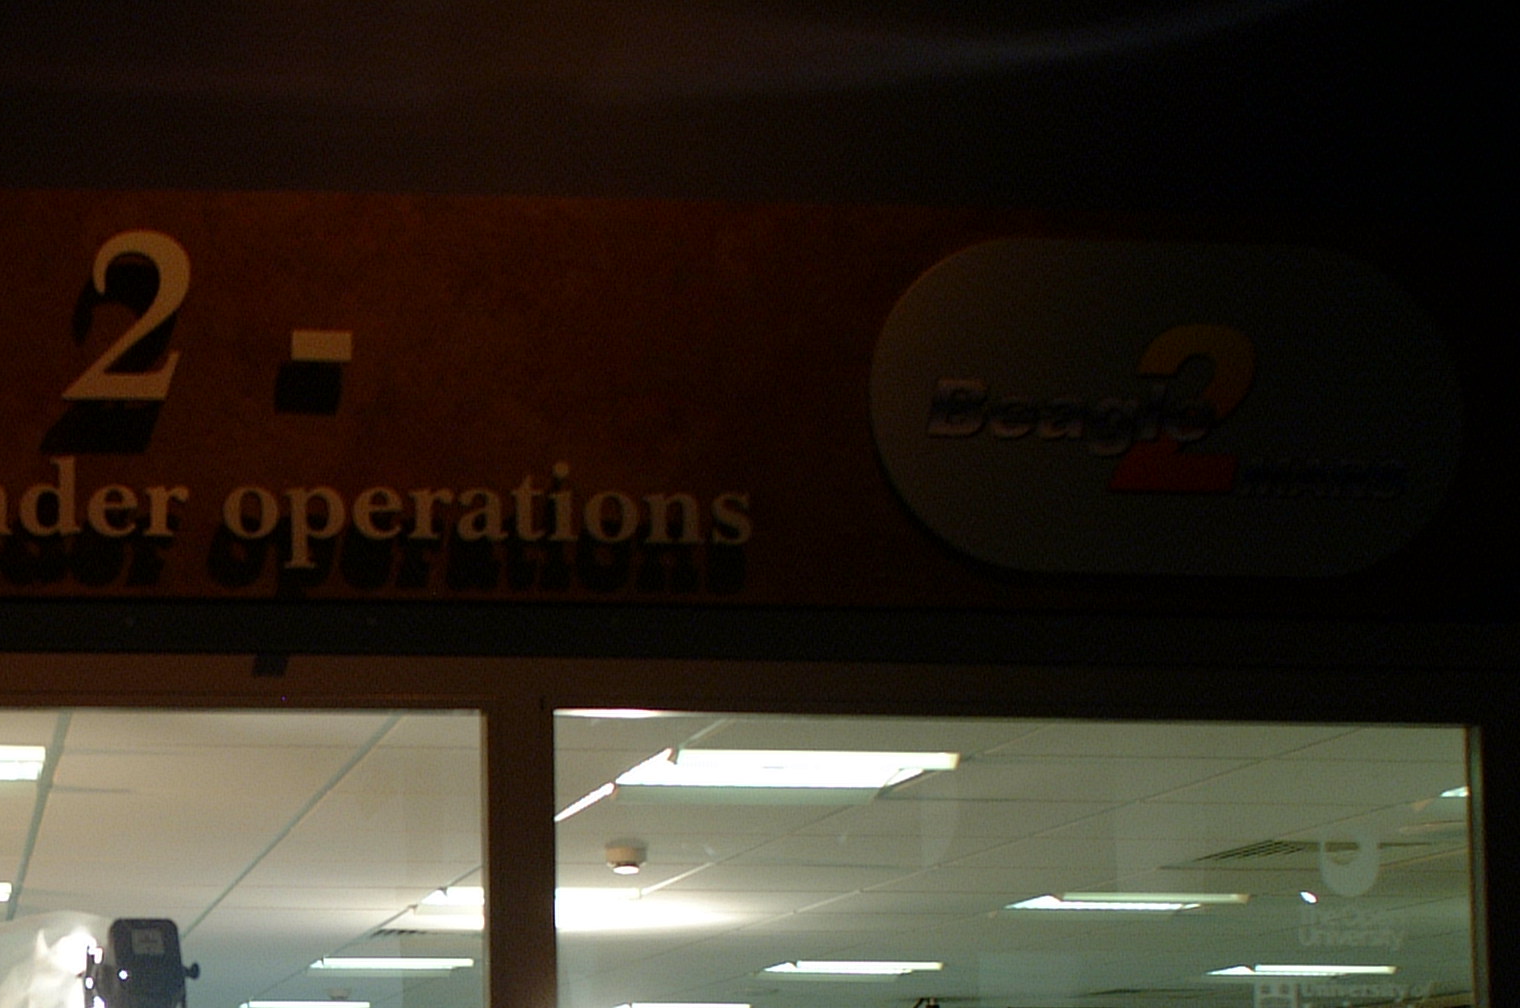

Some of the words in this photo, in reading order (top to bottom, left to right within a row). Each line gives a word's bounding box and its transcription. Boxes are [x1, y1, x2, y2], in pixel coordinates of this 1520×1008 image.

[62, 230, 191, 400] 2
[927, 376, 1217, 456] Beagle
[1108, 323, 1257, 494] 2
[222, 462, 754, 568] operations
